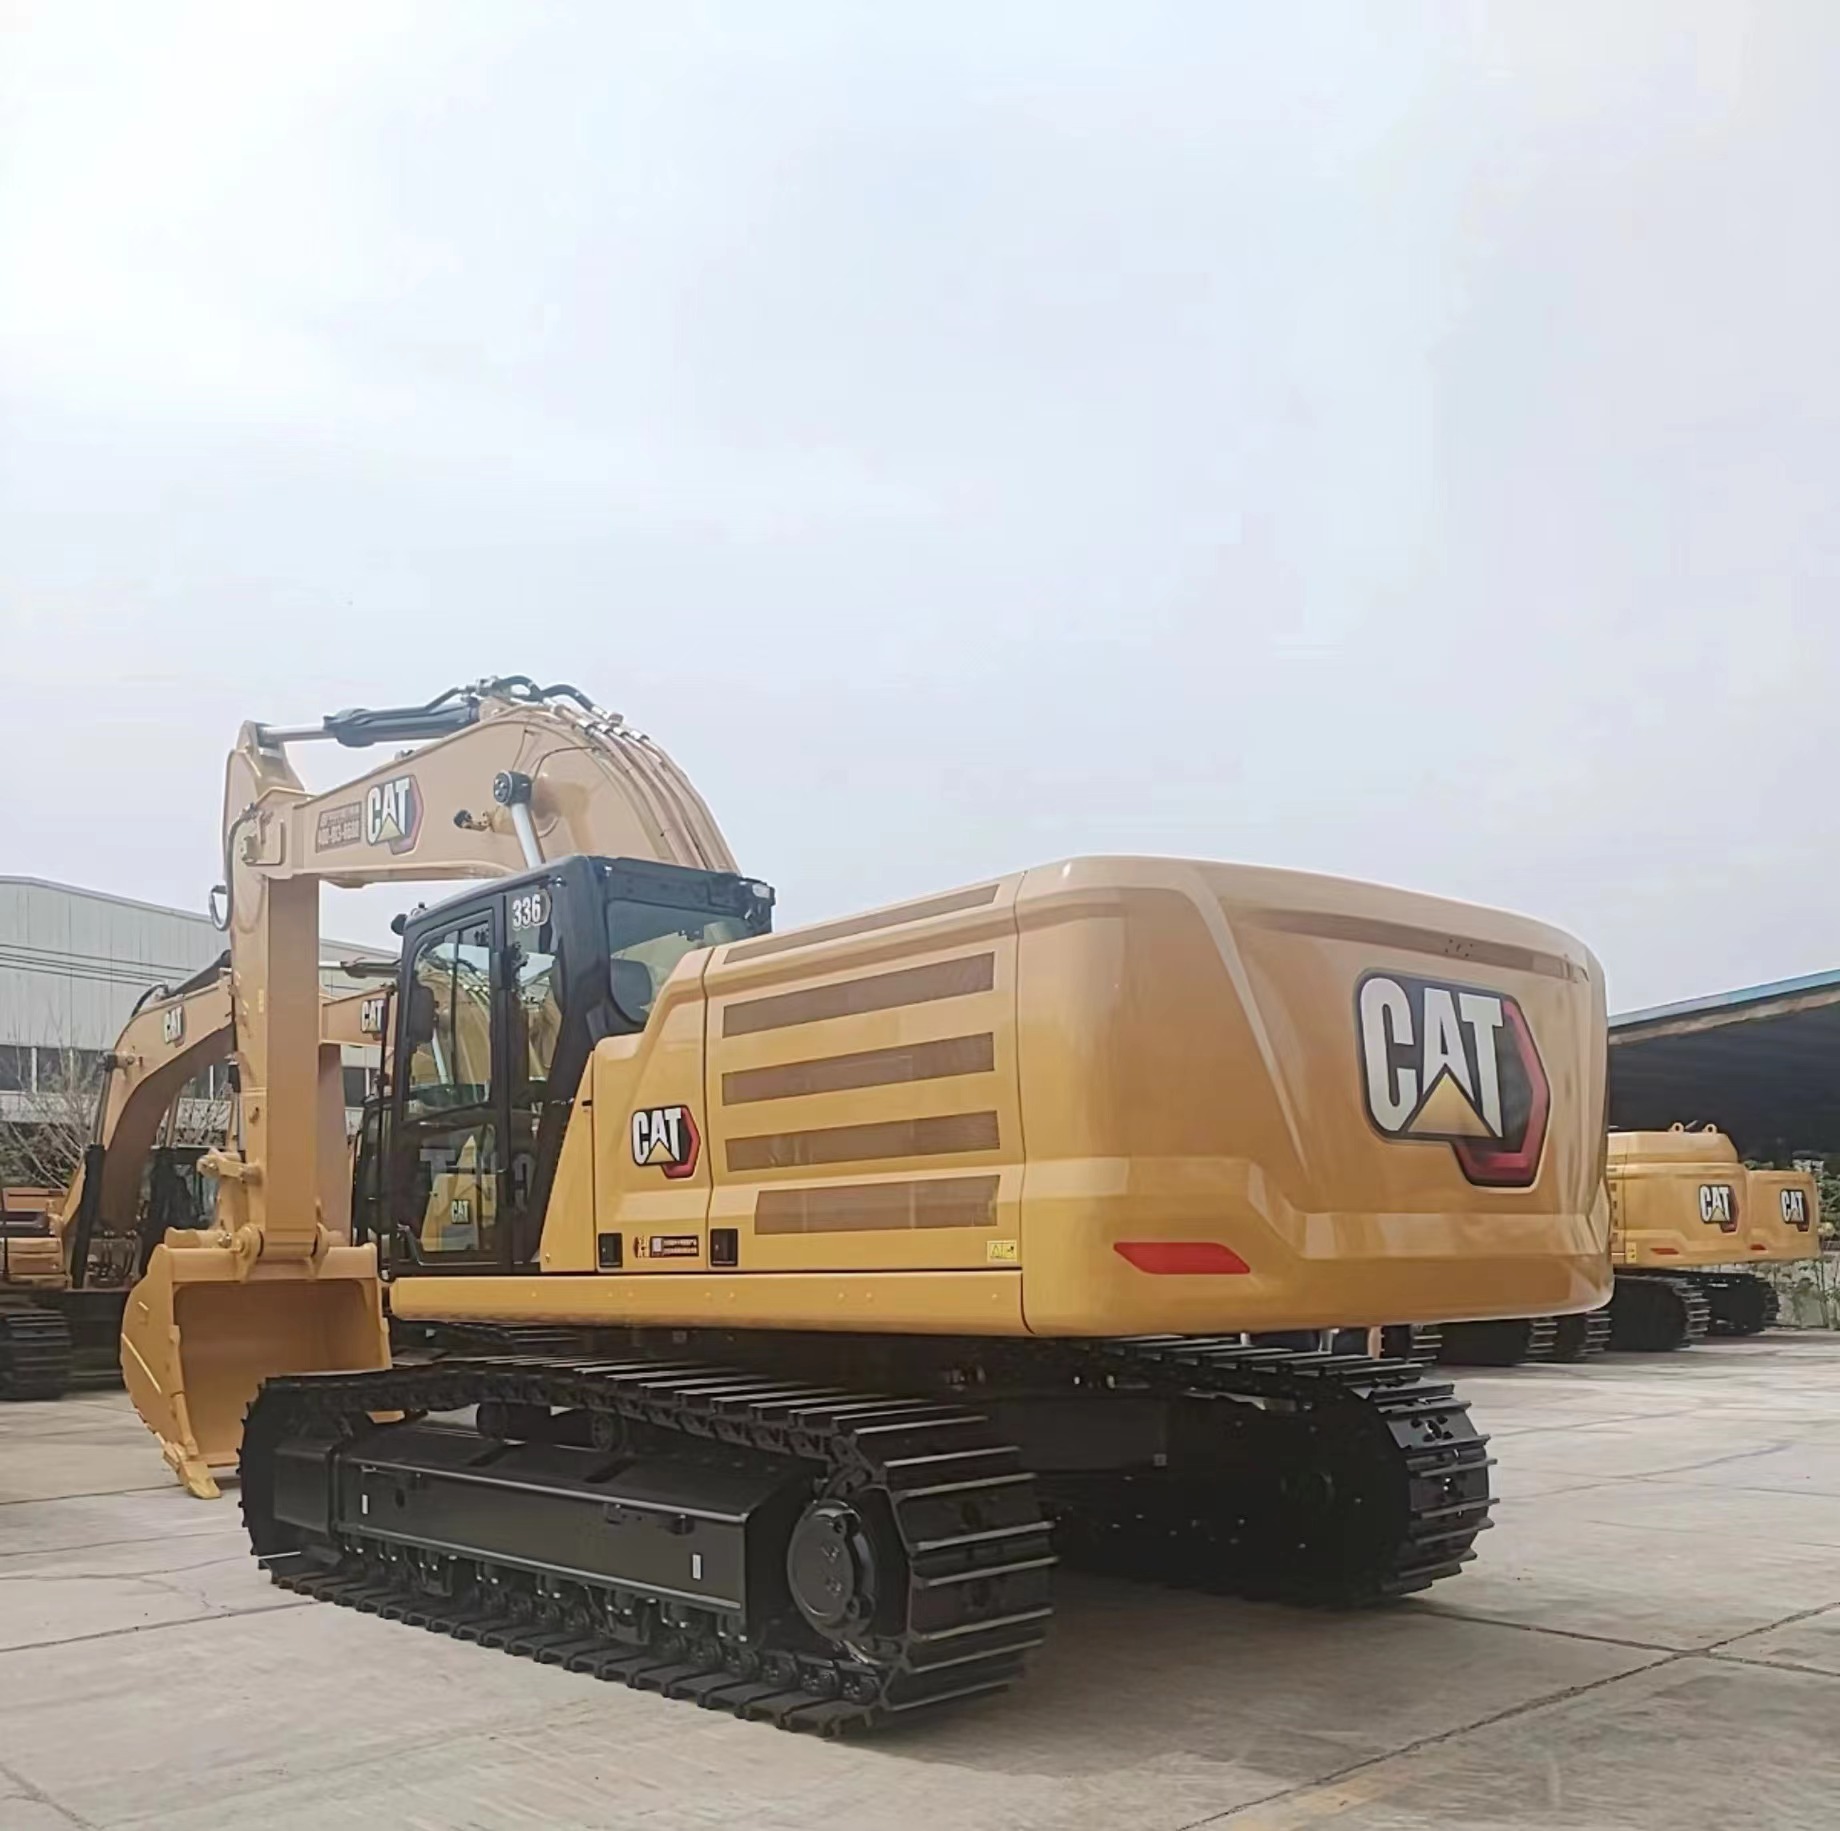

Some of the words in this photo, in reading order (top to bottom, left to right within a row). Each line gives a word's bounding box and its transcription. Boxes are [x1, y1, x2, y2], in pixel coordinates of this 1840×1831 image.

[367, 777, 410, 844] CAT
[512, 894, 541, 928] 336
[361, 1000, 384, 1031] CAT
[1360, 977, 1503, 1138] CAT
[632, 1107, 682, 1164] CAT
[451, 1200, 469, 1222] CAT
[1700, 1185, 1730, 1222] CAT
[1781, 1190, 1804, 1222] CAT
